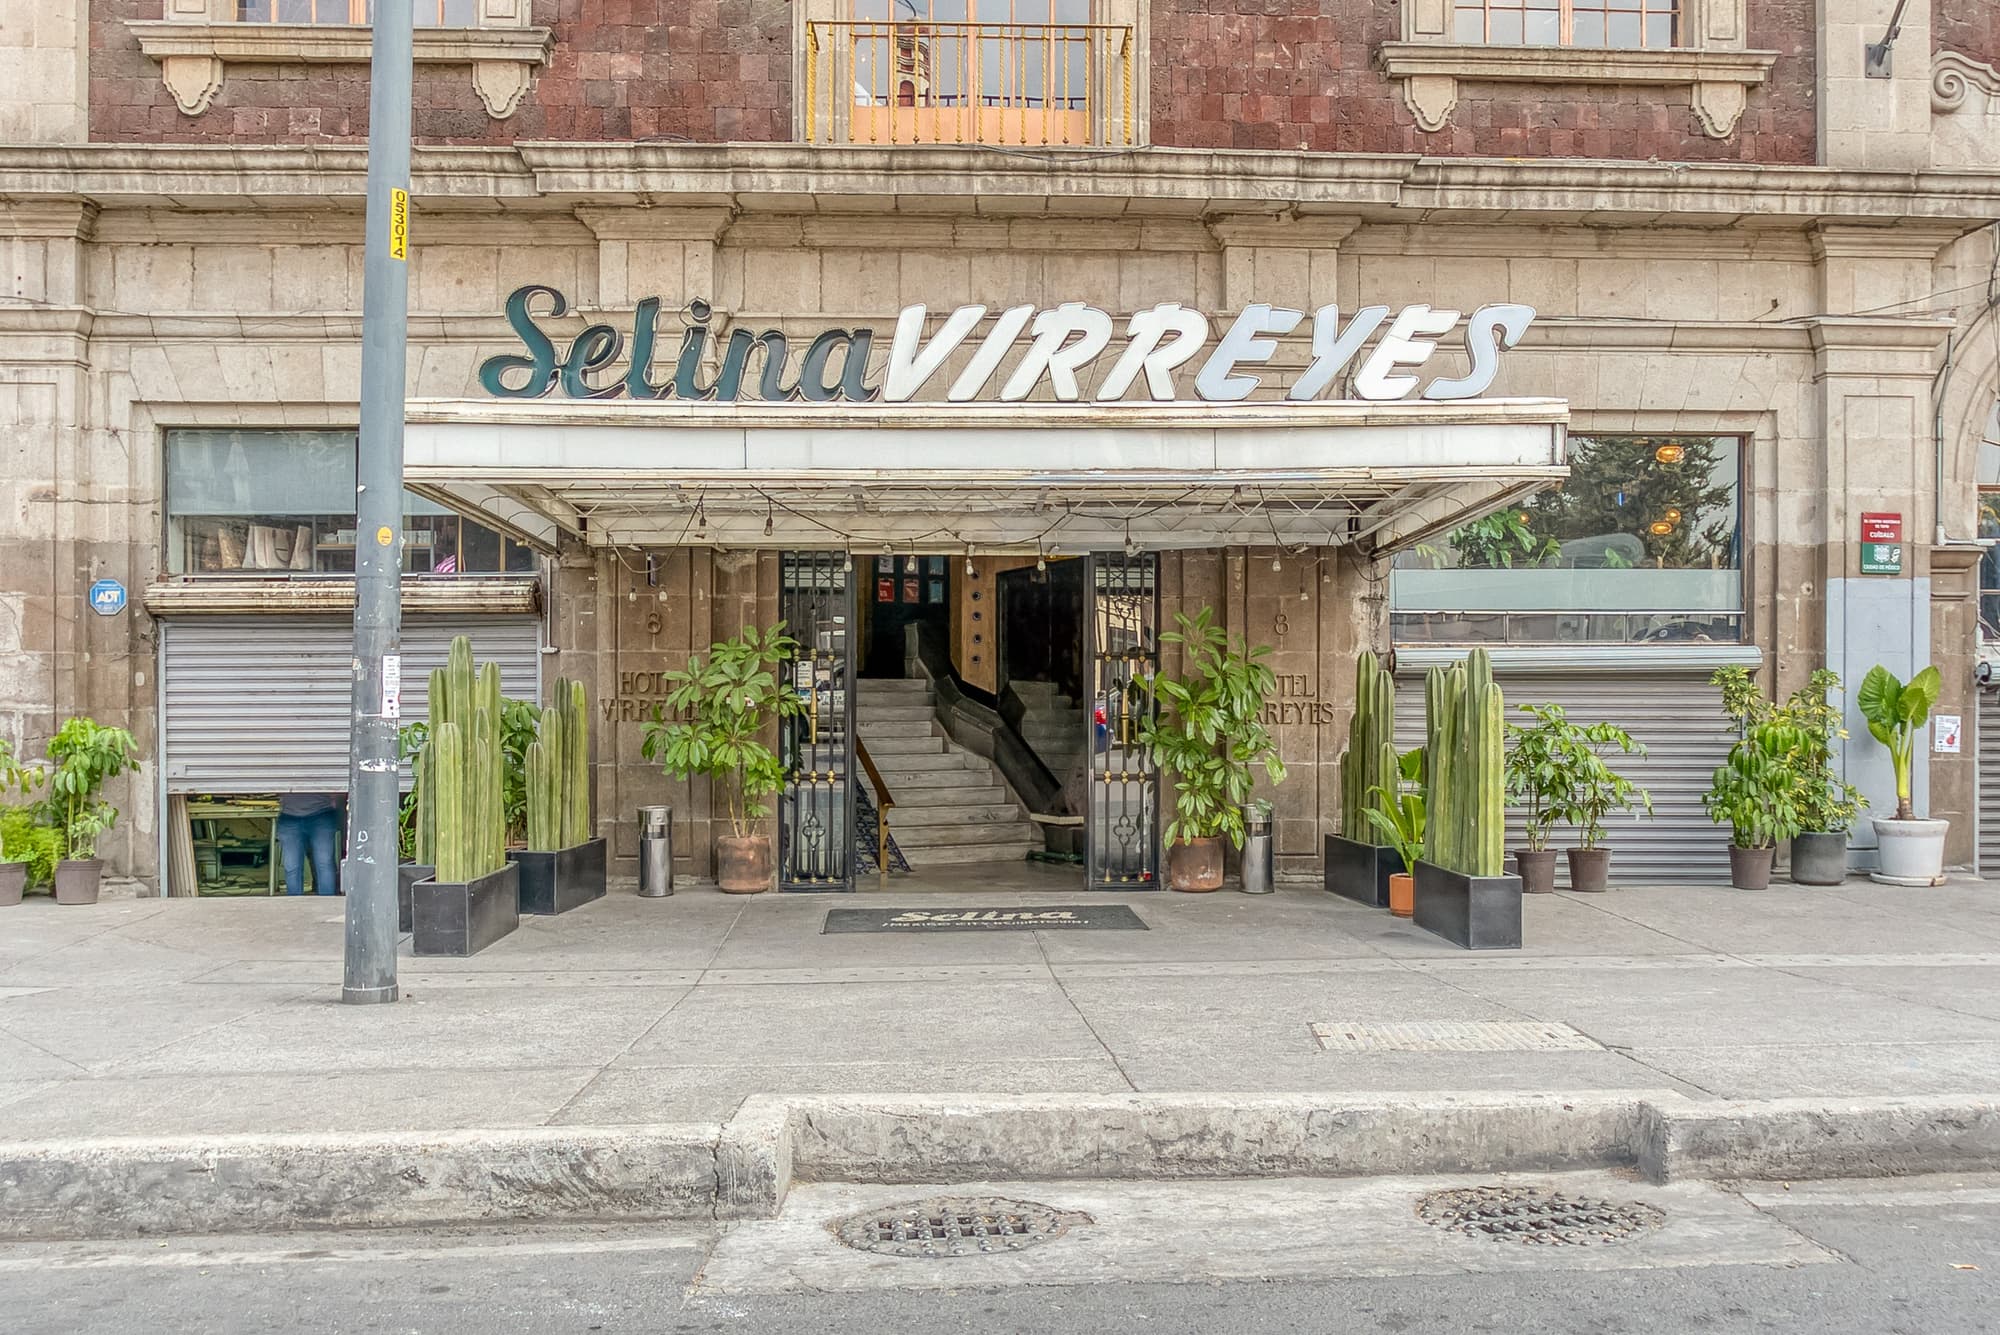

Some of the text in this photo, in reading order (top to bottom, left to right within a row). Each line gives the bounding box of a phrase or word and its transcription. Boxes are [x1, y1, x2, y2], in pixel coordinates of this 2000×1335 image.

[393, 190, 406, 258] 053014
[479, 285, 1537, 402] Selina VIRREYES
[96, 590, 121, 603] ADT
[647, 612, 663, 635] 8
[1274, 613, 1290, 636] 8
[619, 670, 689, 695] HOTE
[1262, 673, 1316, 697] OTEL
[890, 910, 1079, 923] Selina
